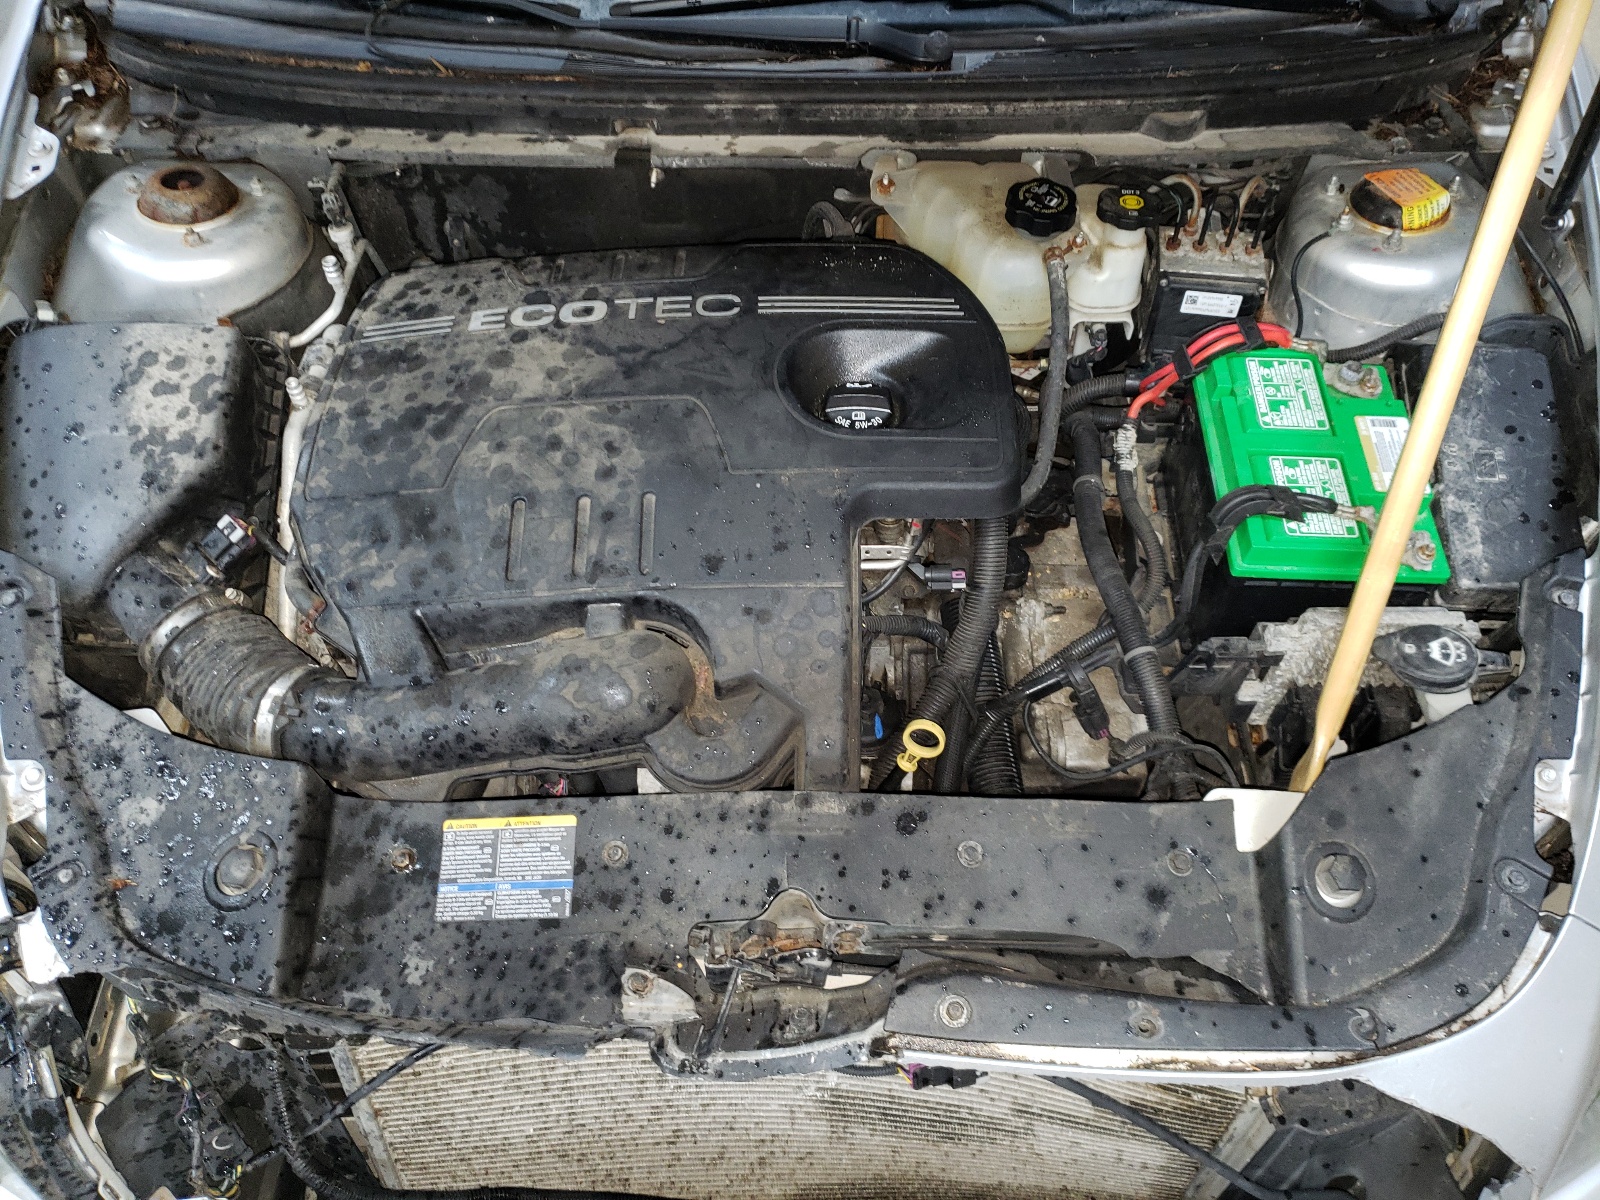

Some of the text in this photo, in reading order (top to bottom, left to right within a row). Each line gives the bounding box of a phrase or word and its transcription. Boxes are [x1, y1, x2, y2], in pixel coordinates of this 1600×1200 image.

[467, 293, 742, 332] ECOTEC
[834, 415, 883, 430] SAE 5W-30
[1272, 460, 1286, 486] POISON
